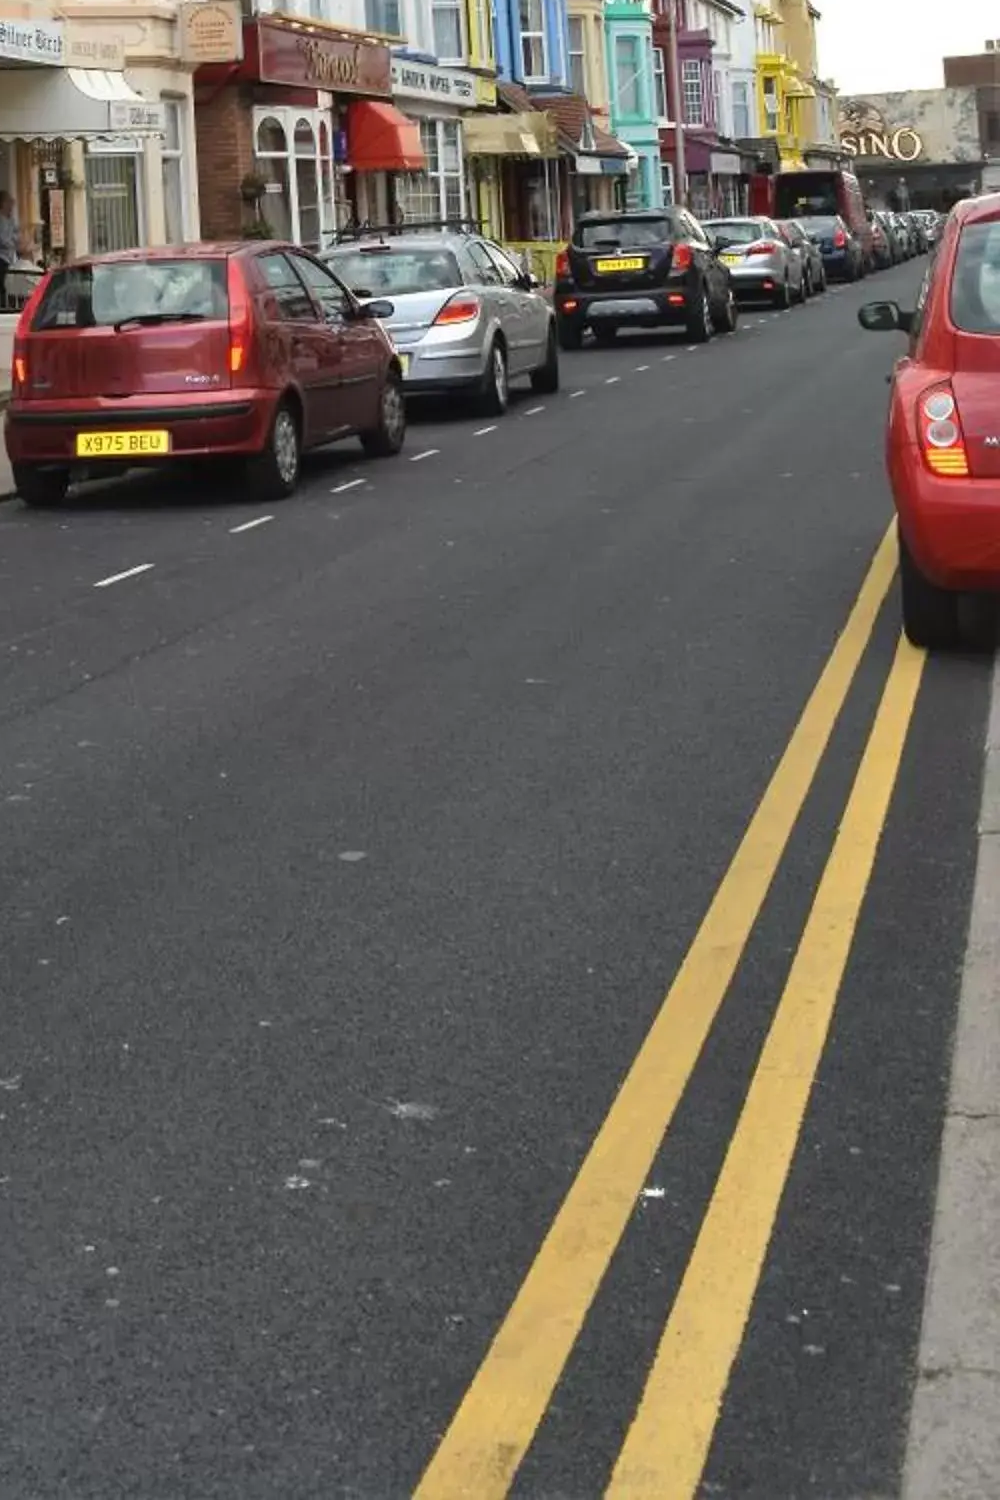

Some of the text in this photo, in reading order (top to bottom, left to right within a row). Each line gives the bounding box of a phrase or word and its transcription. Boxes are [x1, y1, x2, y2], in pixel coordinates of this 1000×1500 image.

[0, 22, 32, 47] Silver
[83, 434, 160, 451] X975 BEU
